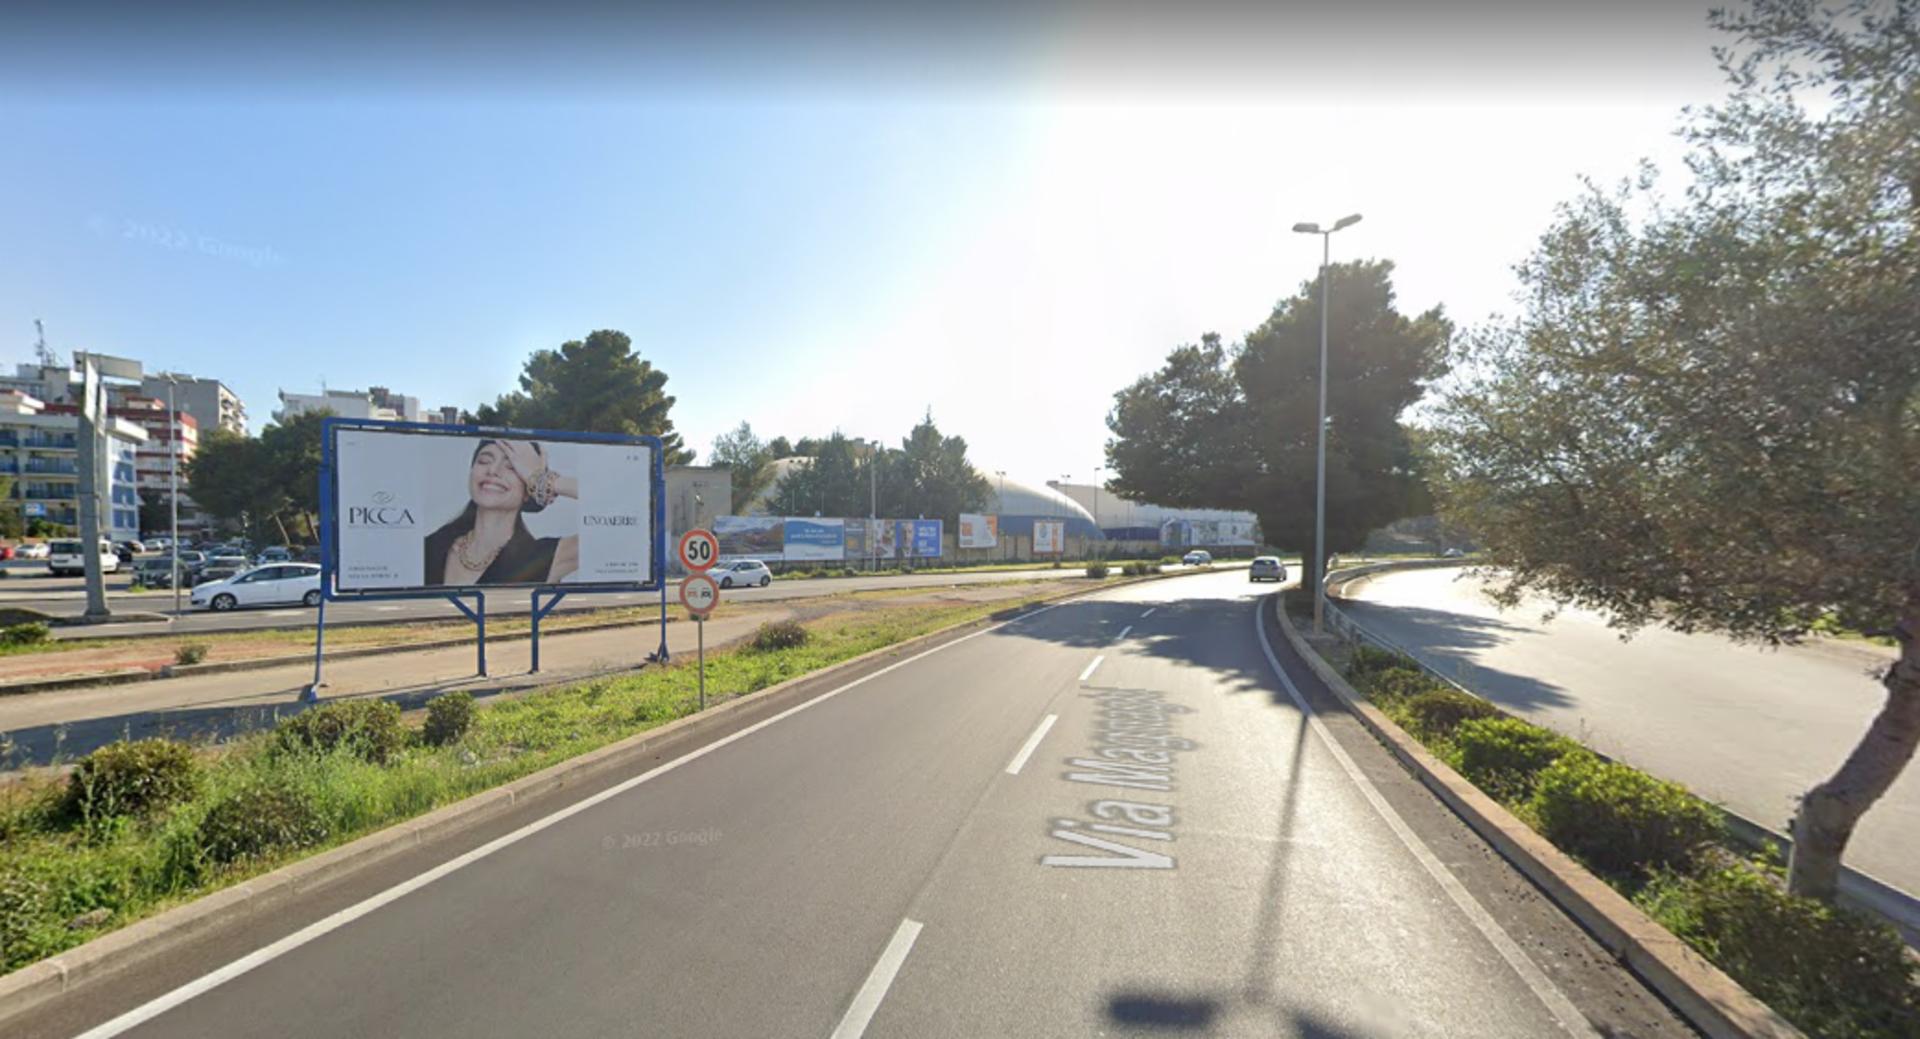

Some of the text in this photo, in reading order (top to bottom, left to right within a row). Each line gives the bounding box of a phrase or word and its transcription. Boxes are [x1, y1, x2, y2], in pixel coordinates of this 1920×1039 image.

[348, 506, 416, 525] PICCA
[583, 514, 640, 526] UNOAERRE
[688, 540, 711, 560] 50
